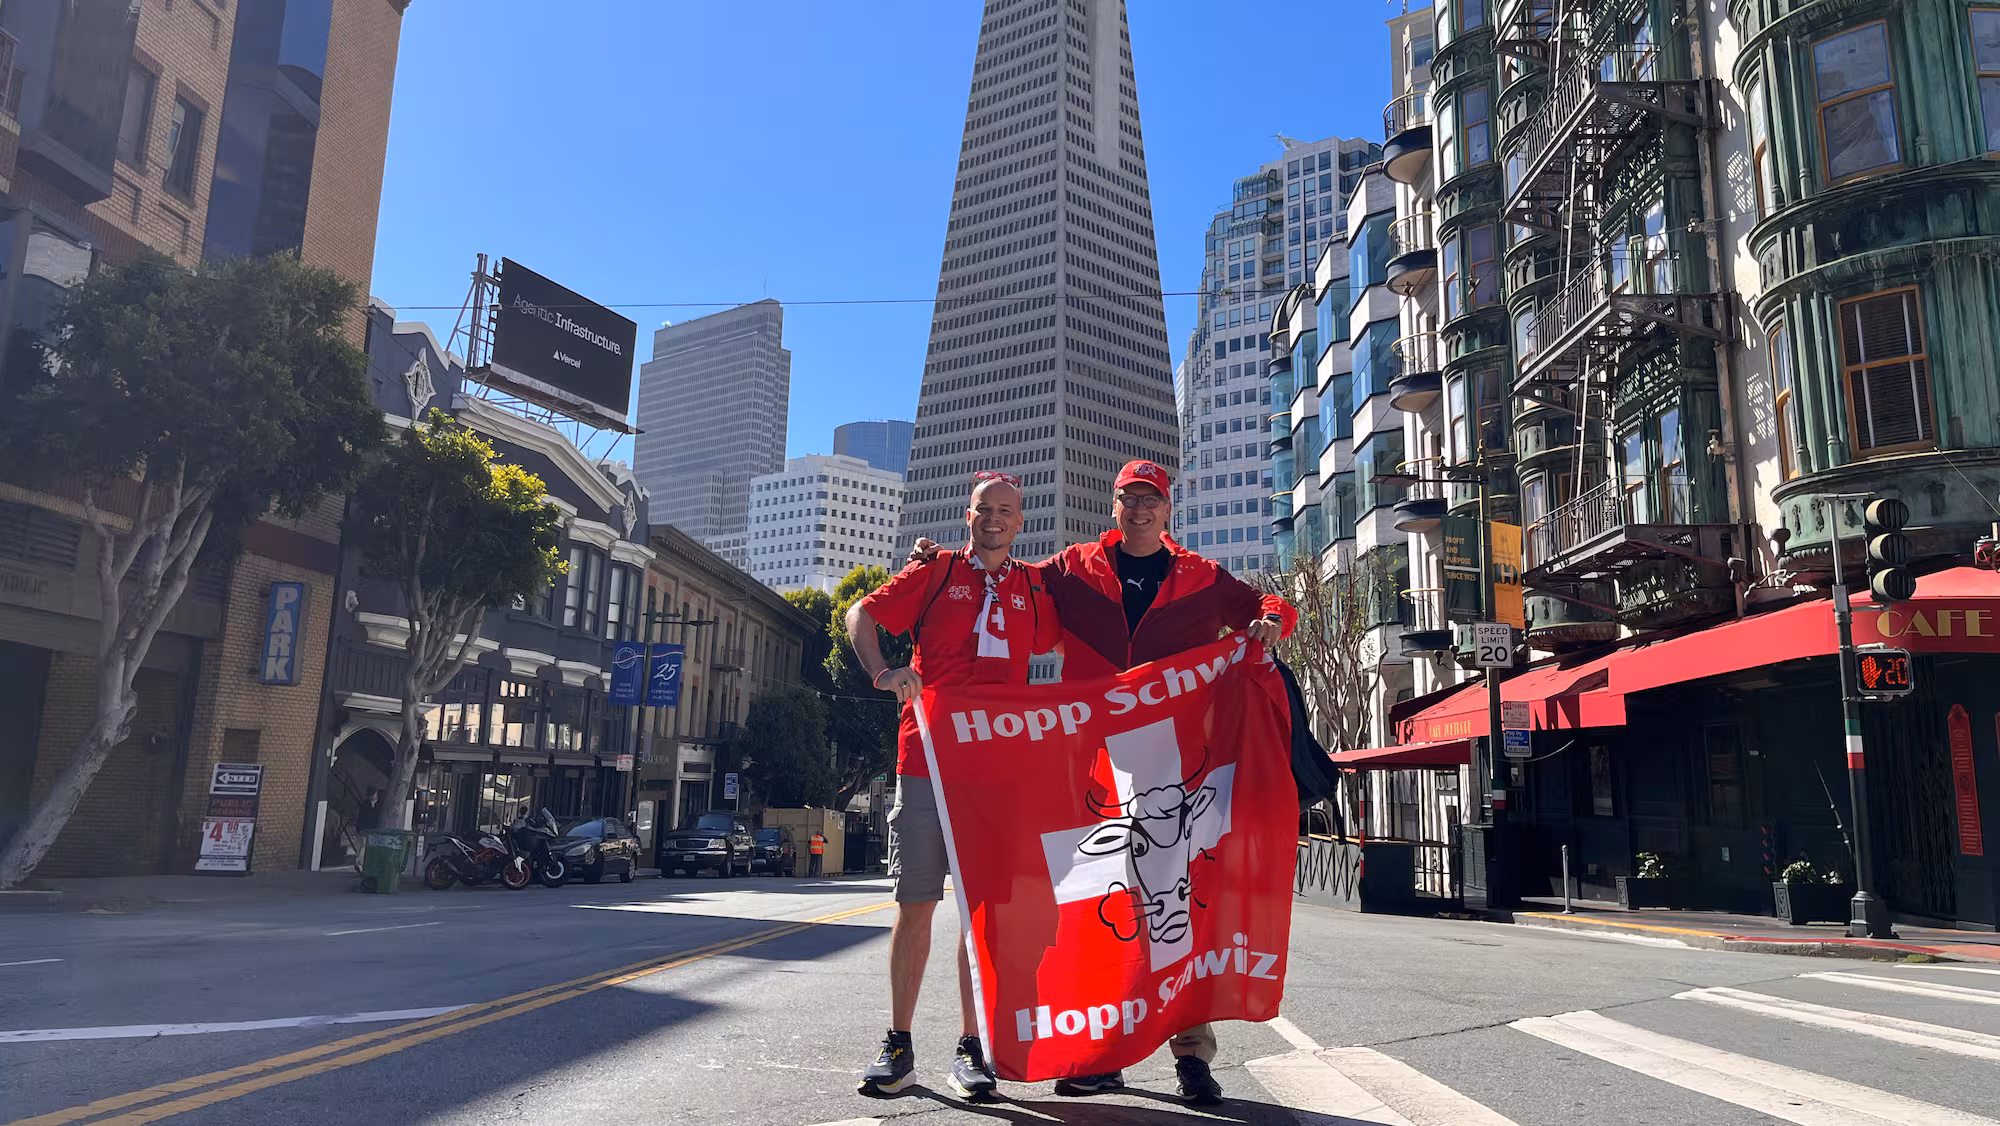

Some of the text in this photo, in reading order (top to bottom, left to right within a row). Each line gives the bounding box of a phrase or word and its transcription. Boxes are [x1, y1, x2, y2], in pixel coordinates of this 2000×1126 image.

[513, 294, 622, 356] Agentic Infrastructure.
[560, 353, 582, 368] Vercel
[1445, 536, 1465, 544] PROFIT
[1445, 546, 1458, 554] AND
[1445, 556, 1472, 565] PURPOSE
[1447, 572, 1463, 580] SINCE
[1478, 627, 1508, 635] SPEED
[1876, 609, 1994, 638] CAFE
[265, 586, 298, 681] PARK
[1481, 636, 1505, 644] LIMIT
[1480, 645, 1508, 662] 20
[653, 663, 680, 681] 25
[1885, 657, 1908, 685] 20
[951, 636, 1276, 743] Hopp Schwi
[209, 821, 223, 843] 4
[1015, 998, 1148, 1042] Hopp
